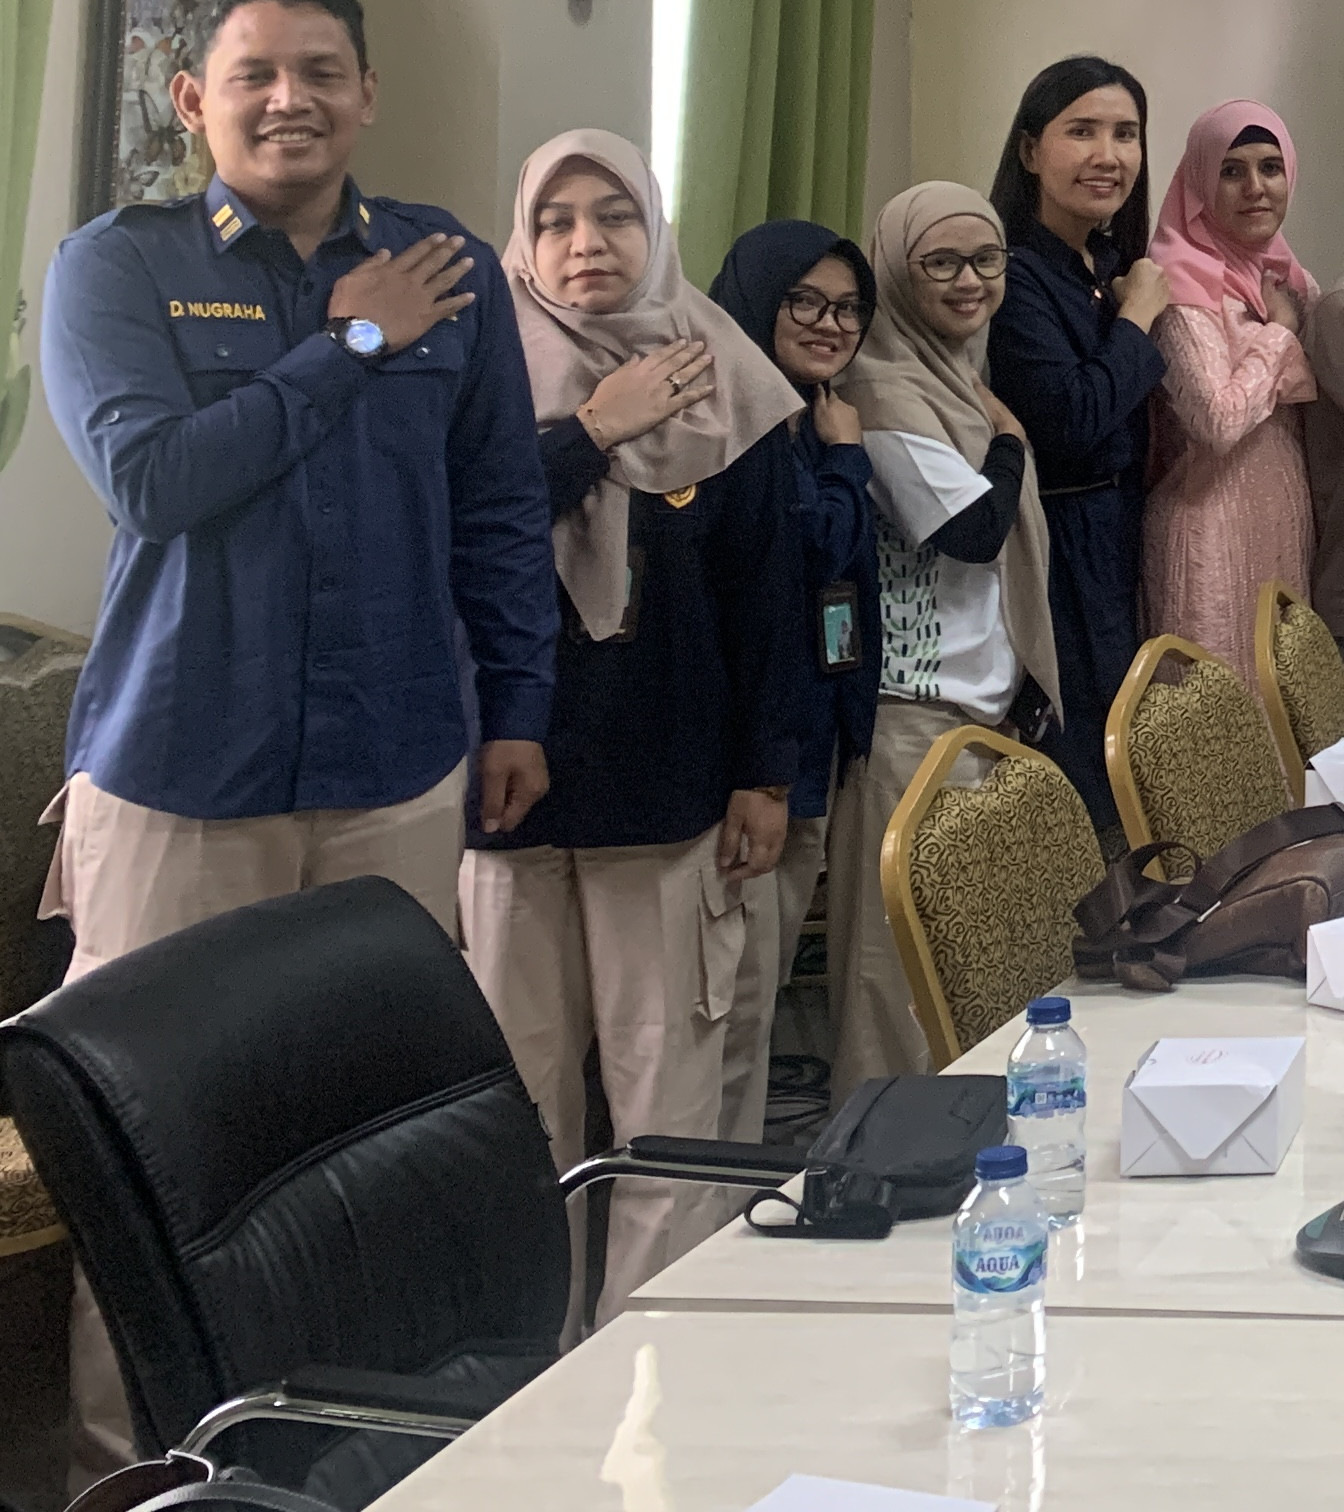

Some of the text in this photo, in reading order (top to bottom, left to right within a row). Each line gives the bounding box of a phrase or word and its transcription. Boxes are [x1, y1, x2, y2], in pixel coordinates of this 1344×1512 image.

[169, 300, 266, 321] D. NUGRAHA
[976, 1254, 1020, 1275] AQUA
